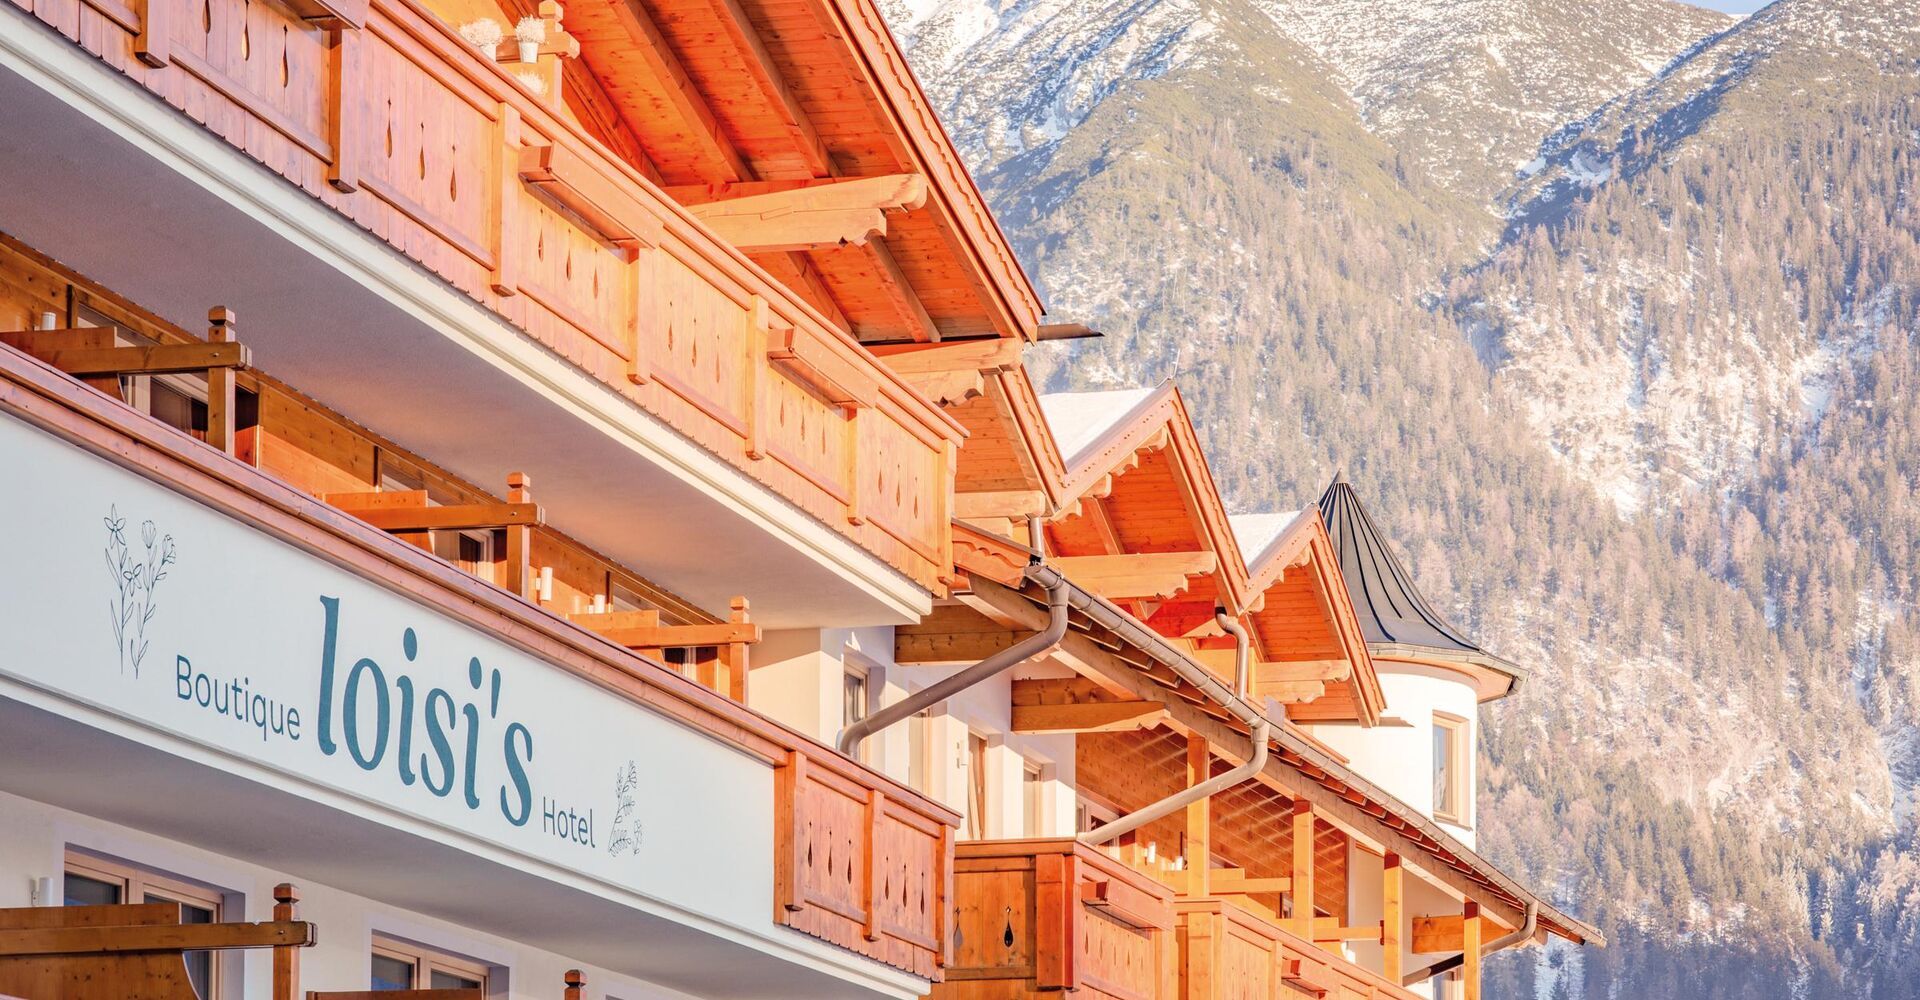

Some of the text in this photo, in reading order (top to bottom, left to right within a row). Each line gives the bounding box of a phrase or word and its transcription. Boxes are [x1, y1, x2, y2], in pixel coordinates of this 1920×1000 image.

[176, 595, 596, 848] Boutique loisi's Hotel
